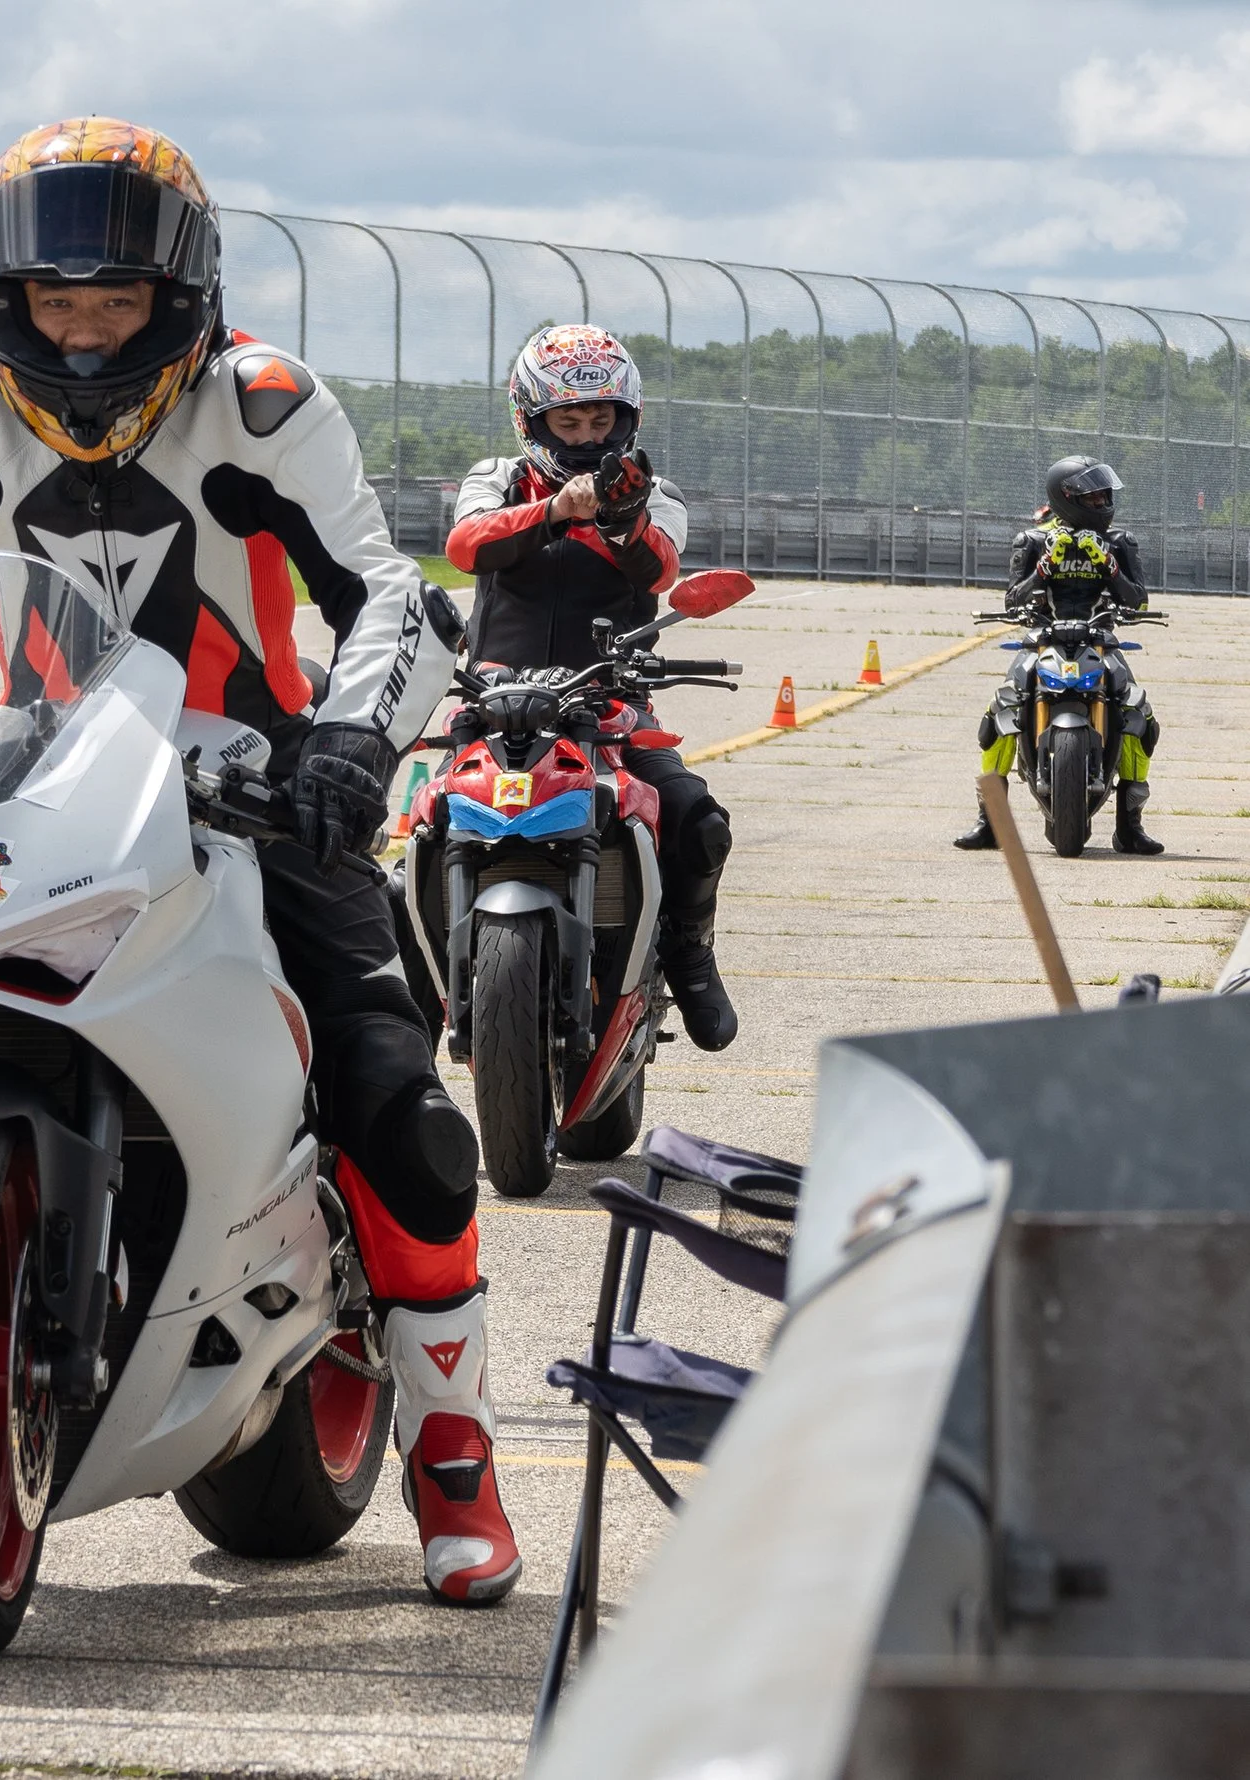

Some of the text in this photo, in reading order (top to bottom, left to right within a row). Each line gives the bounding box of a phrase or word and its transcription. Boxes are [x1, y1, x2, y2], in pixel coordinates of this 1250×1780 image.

[565, 367, 606, 383] Arai
[1059, 559, 1097, 574] UCA
[370, 591, 425, 735] DAINESE
[868, 648, 877, 663] 7
[781, 686, 792, 703] 6
[219, 731, 262, 764] DUCATI
[48, 875, 93, 898] DUCATI
[225, 1176, 300, 1239] PANIGALE
